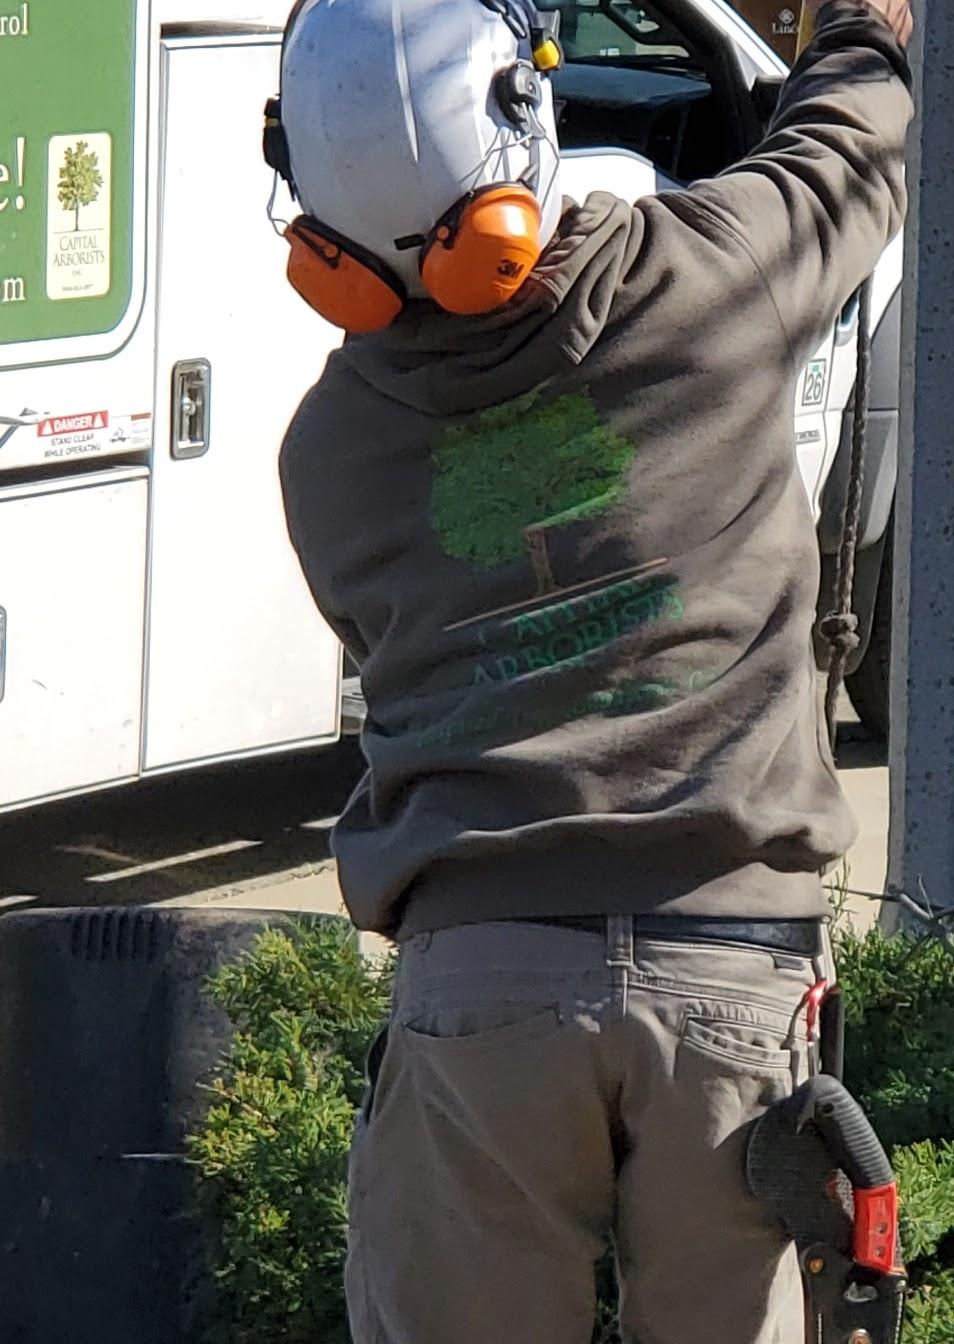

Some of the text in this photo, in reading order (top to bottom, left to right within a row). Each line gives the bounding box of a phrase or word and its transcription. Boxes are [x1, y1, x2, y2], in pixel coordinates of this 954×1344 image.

[772, 22, 799, 34] Linc
[59, 234, 99, 251] CAPITAL
[53, 249, 105, 267] ARBORISTS
[496, 259, 525, 278] 3M
[804, 372, 822, 401] 26
[53, 415, 92, 433] DANGER
[51, 433, 94, 446] STAND CLEAR
[44, 448, 64, 458] WHILE
